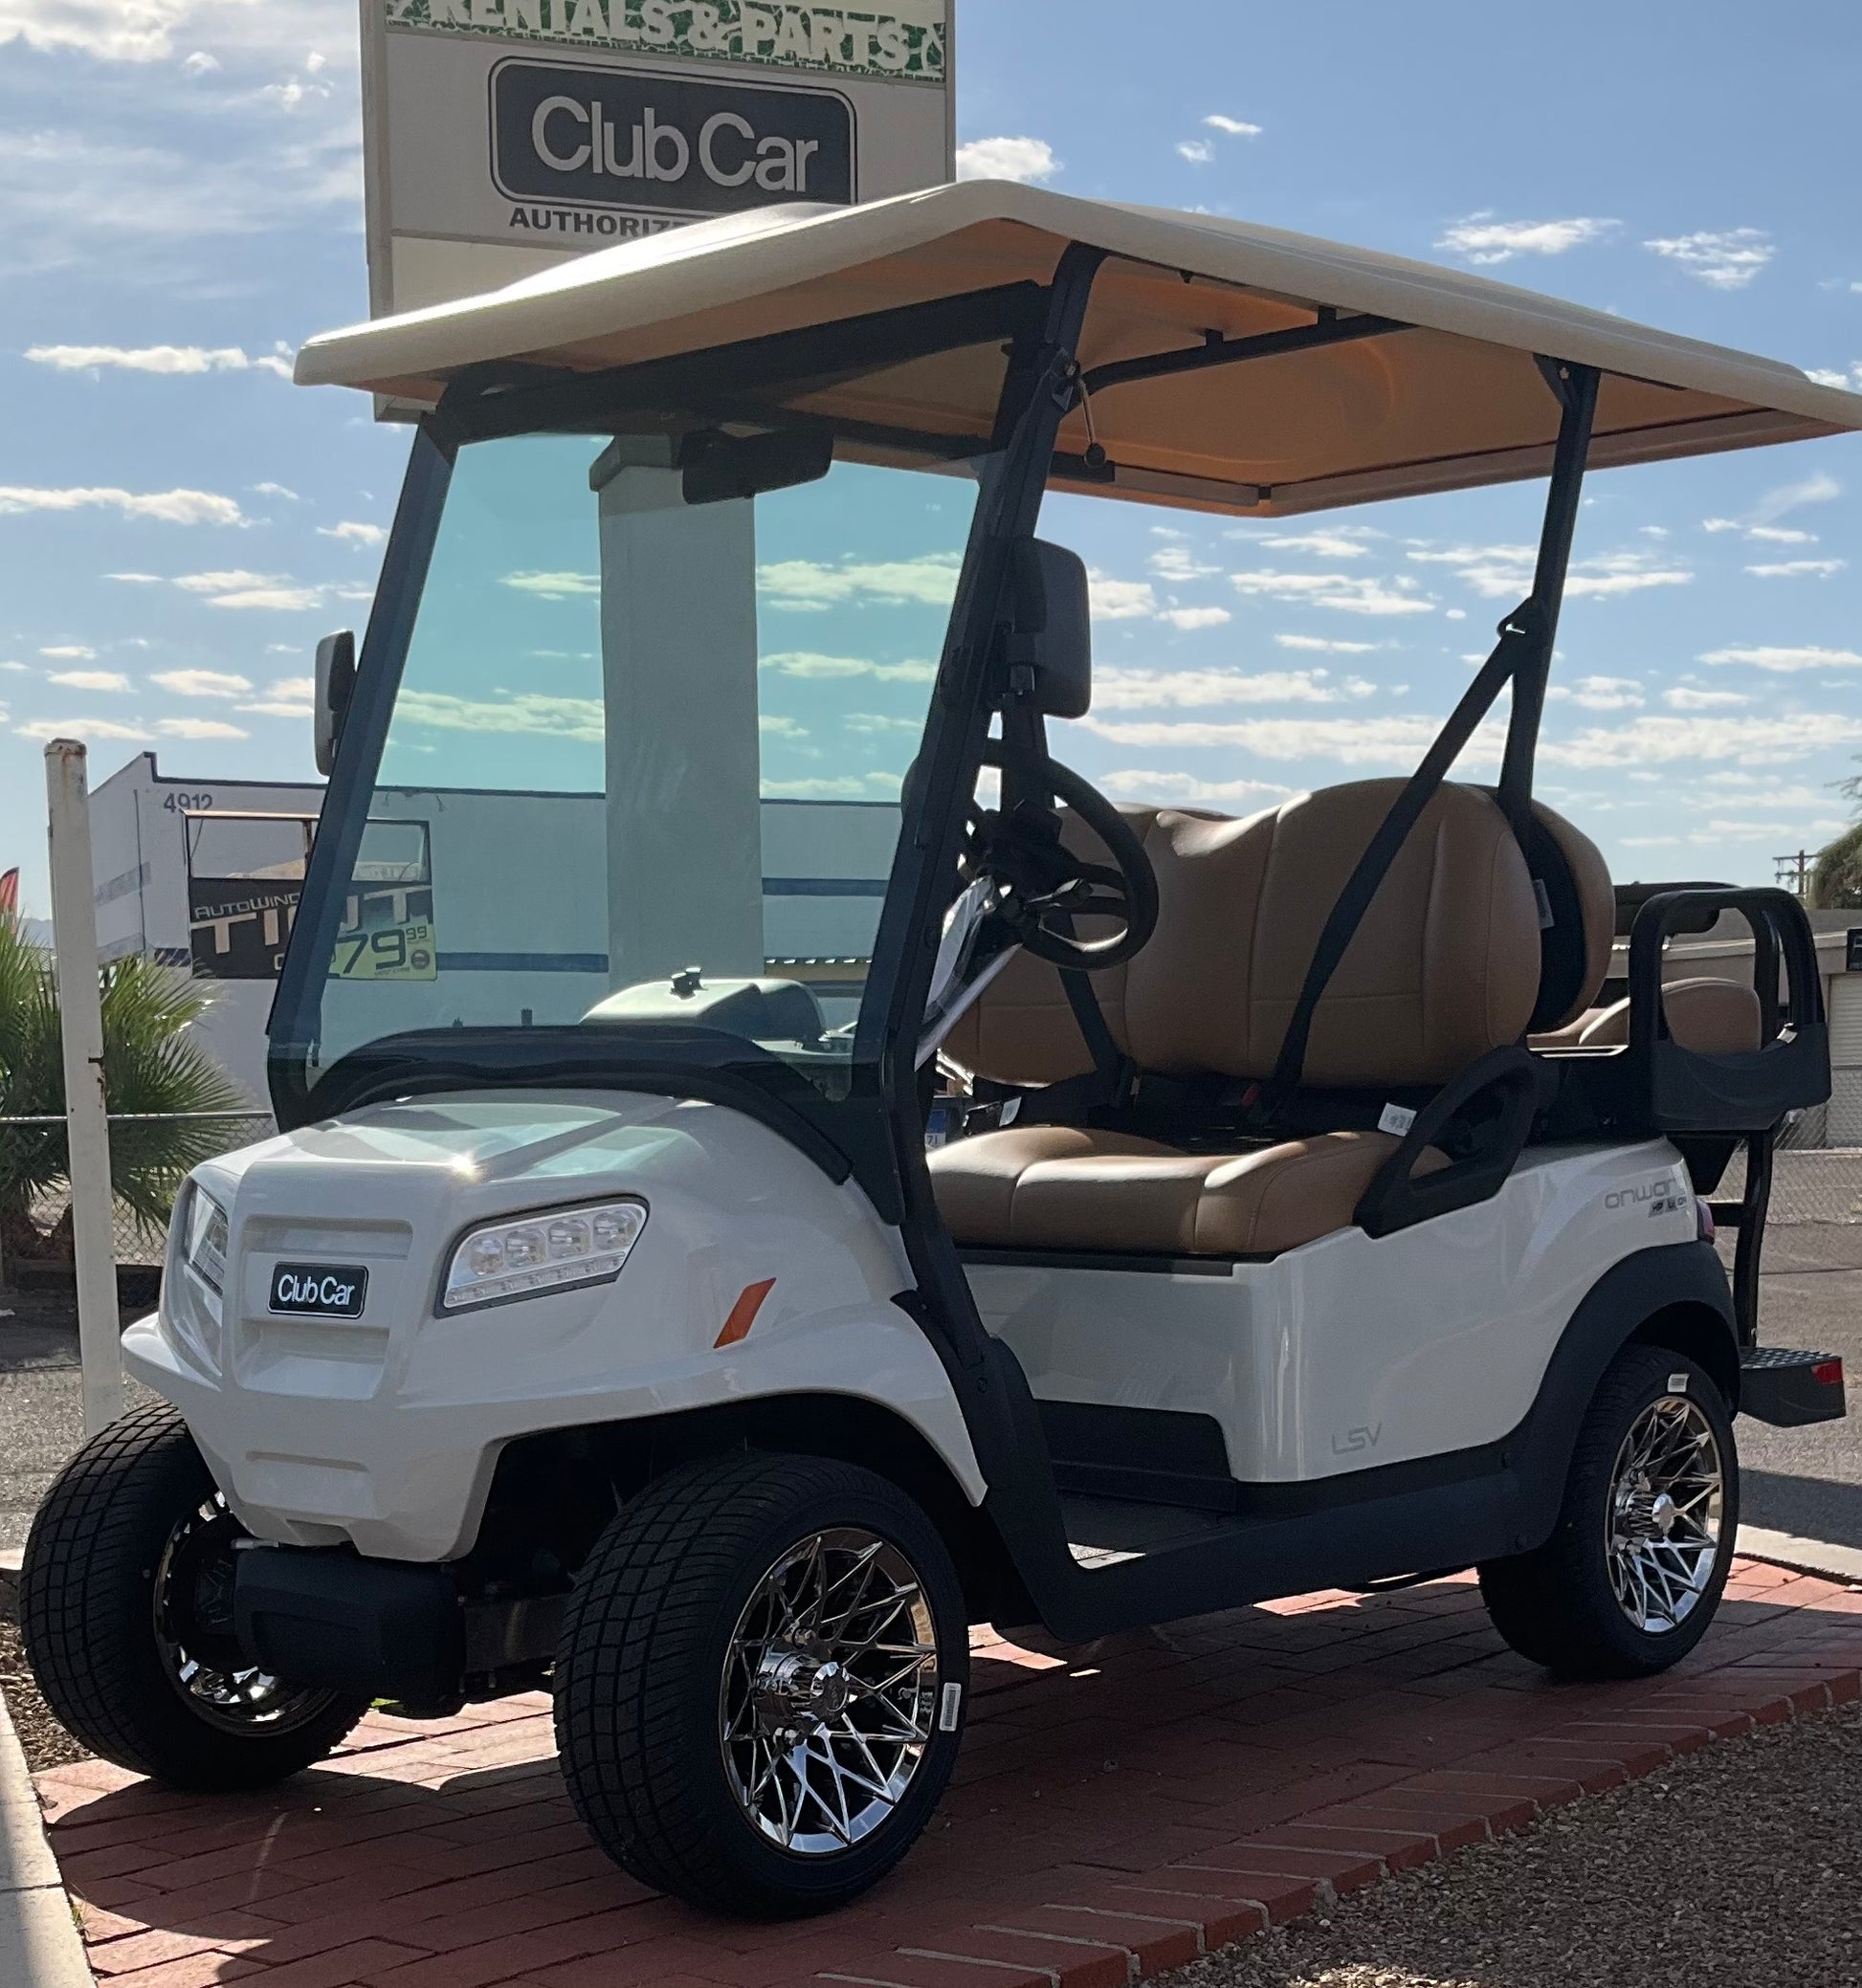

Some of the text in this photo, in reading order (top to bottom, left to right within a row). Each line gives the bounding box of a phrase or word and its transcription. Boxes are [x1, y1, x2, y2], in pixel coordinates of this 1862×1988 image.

[741, 7, 910, 71] PARTS
[532, 96, 818, 192] Club Car
[509, 207, 690, 238] AUTHORIZ
[164, 792, 213, 813] 4912
[277, 1273, 356, 1306] Club Car
[1331, 1422, 1383, 1455] LSV
